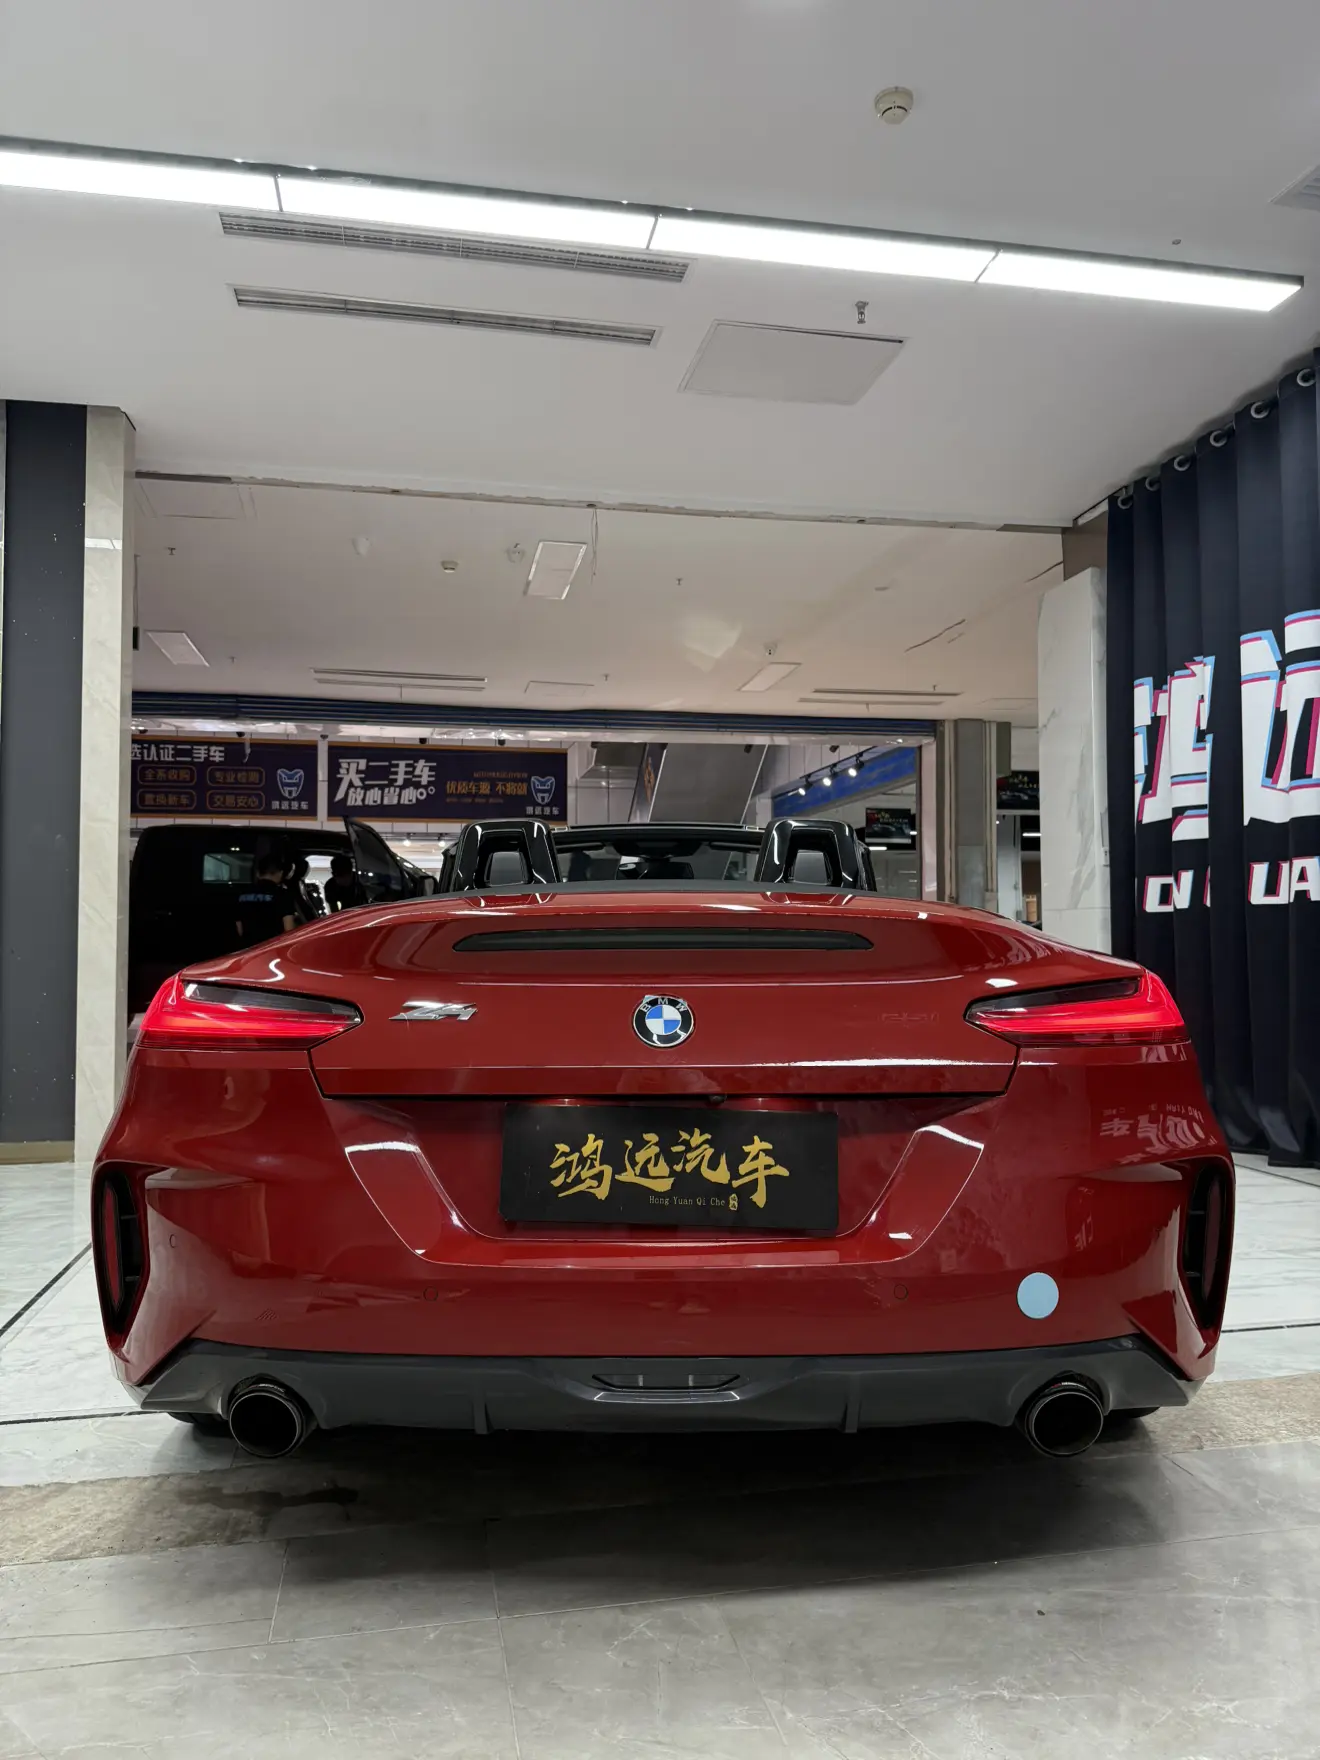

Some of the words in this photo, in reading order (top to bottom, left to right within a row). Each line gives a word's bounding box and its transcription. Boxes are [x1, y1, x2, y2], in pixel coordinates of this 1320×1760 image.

[334, 759, 437, 802] 买二手车
[347, 786, 417, 806] 放心省心
[388, 1001, 478, 1021] Z4
[640, 997, 688, 1013] BMW
[549, 1127, 790, 1209] 鸿远汽车
[649, 1195, 670, 1206] Hong
[673, 1196, 693, 1206] Yuan
[696, 1197, 706, 1207] Qi
[710, 1198, 726, 1207] Che
